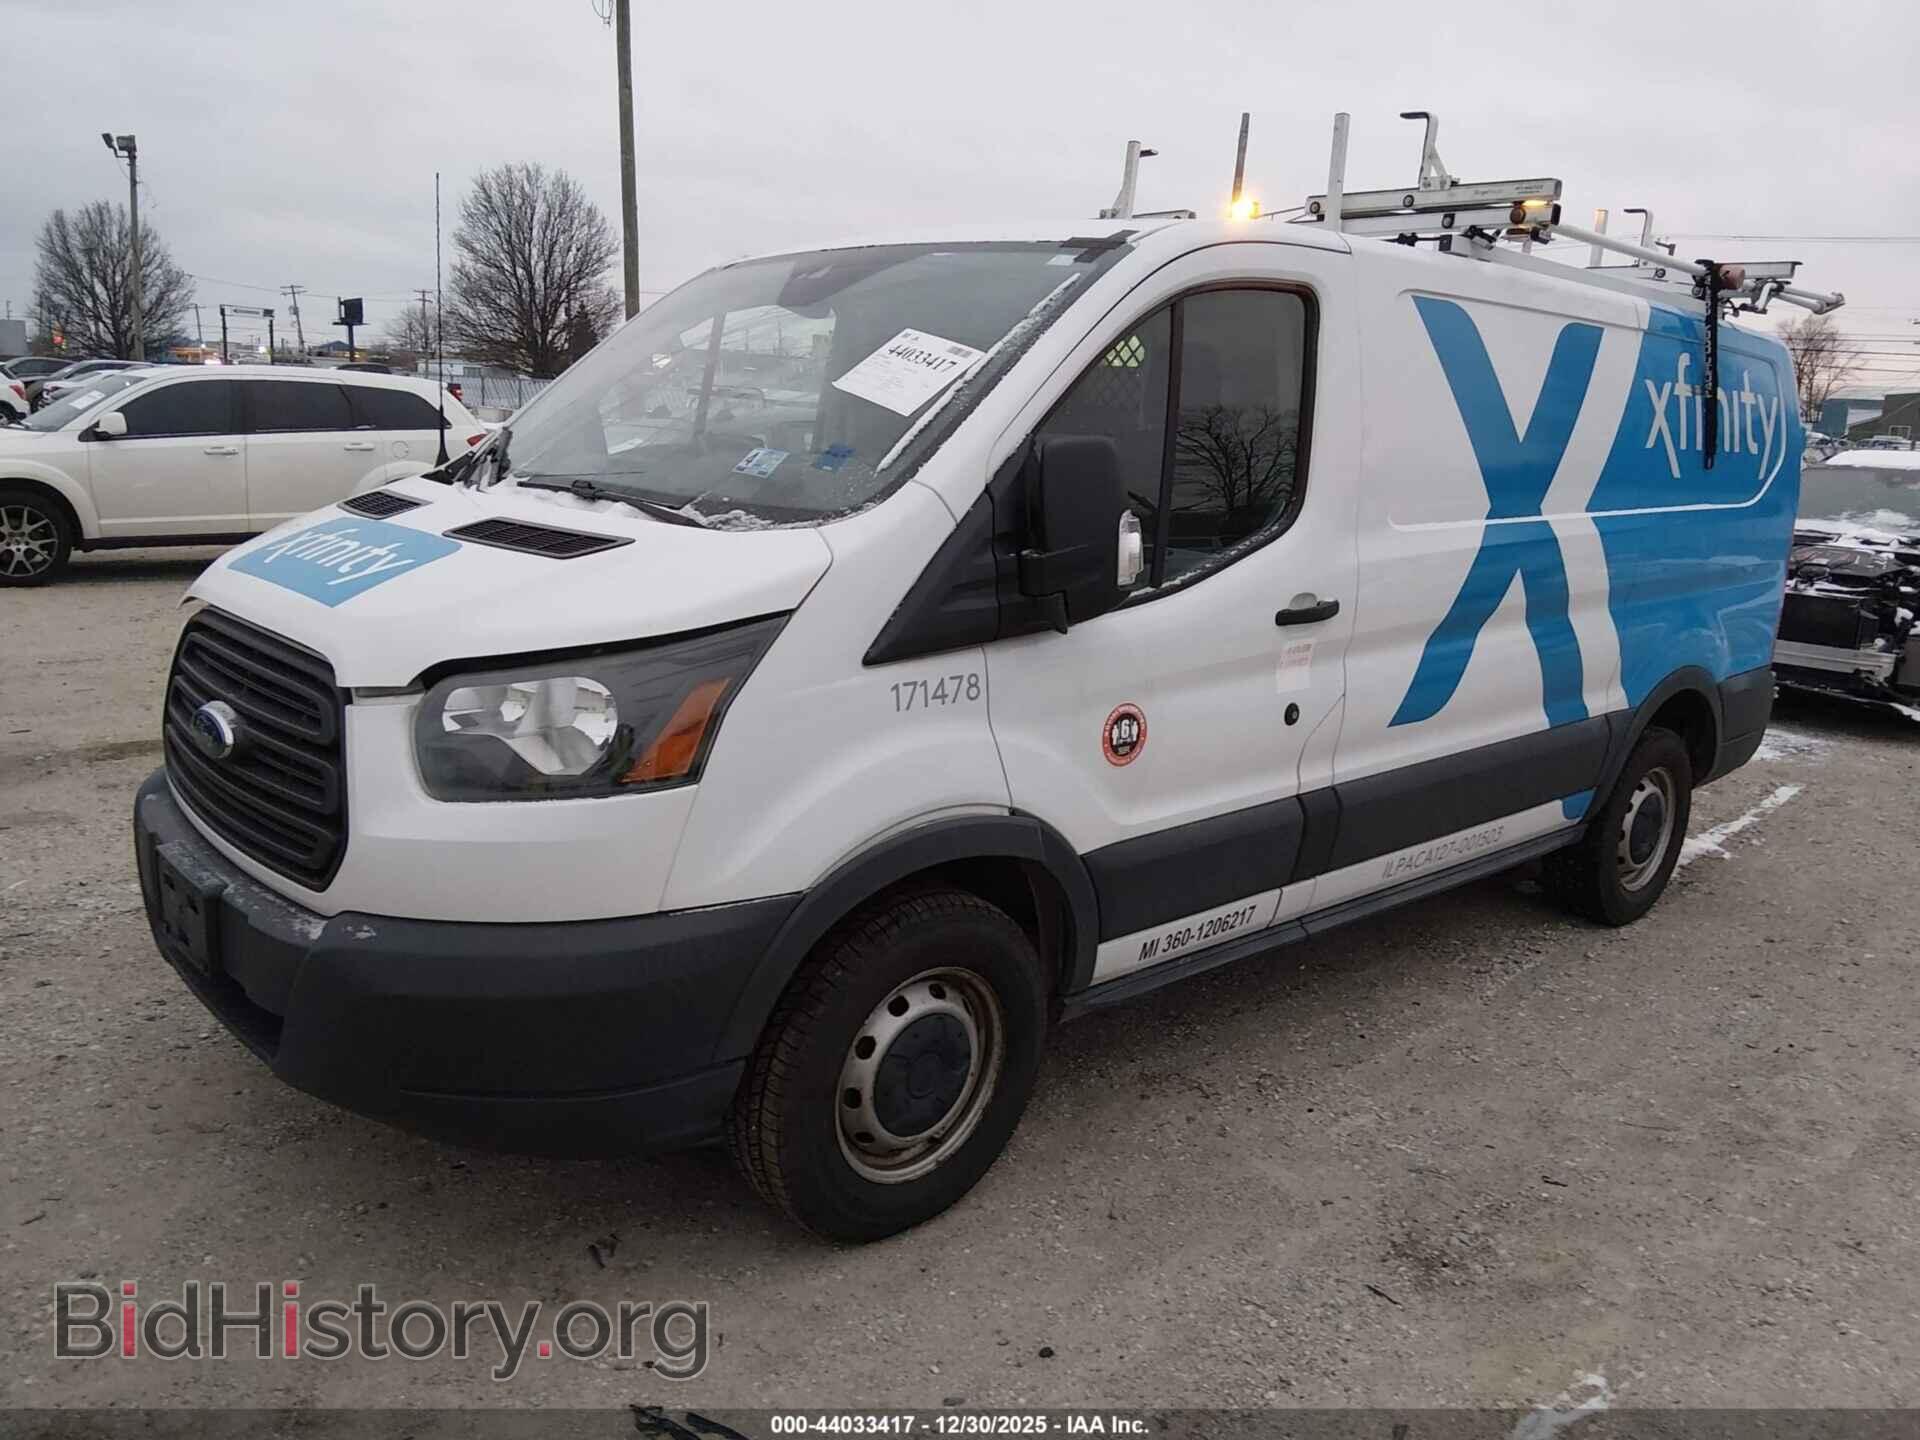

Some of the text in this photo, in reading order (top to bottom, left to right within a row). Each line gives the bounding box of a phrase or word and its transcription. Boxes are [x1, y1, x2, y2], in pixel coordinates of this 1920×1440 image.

[887, 344, 957, 373] 44033417
[1644, 353, 1779, 481] xfinity
[262, 527, 415, 586] xfinity
[889, 672, 981, 713] 171478
[1138, 904, 1257, 961] MI 360-1206217
